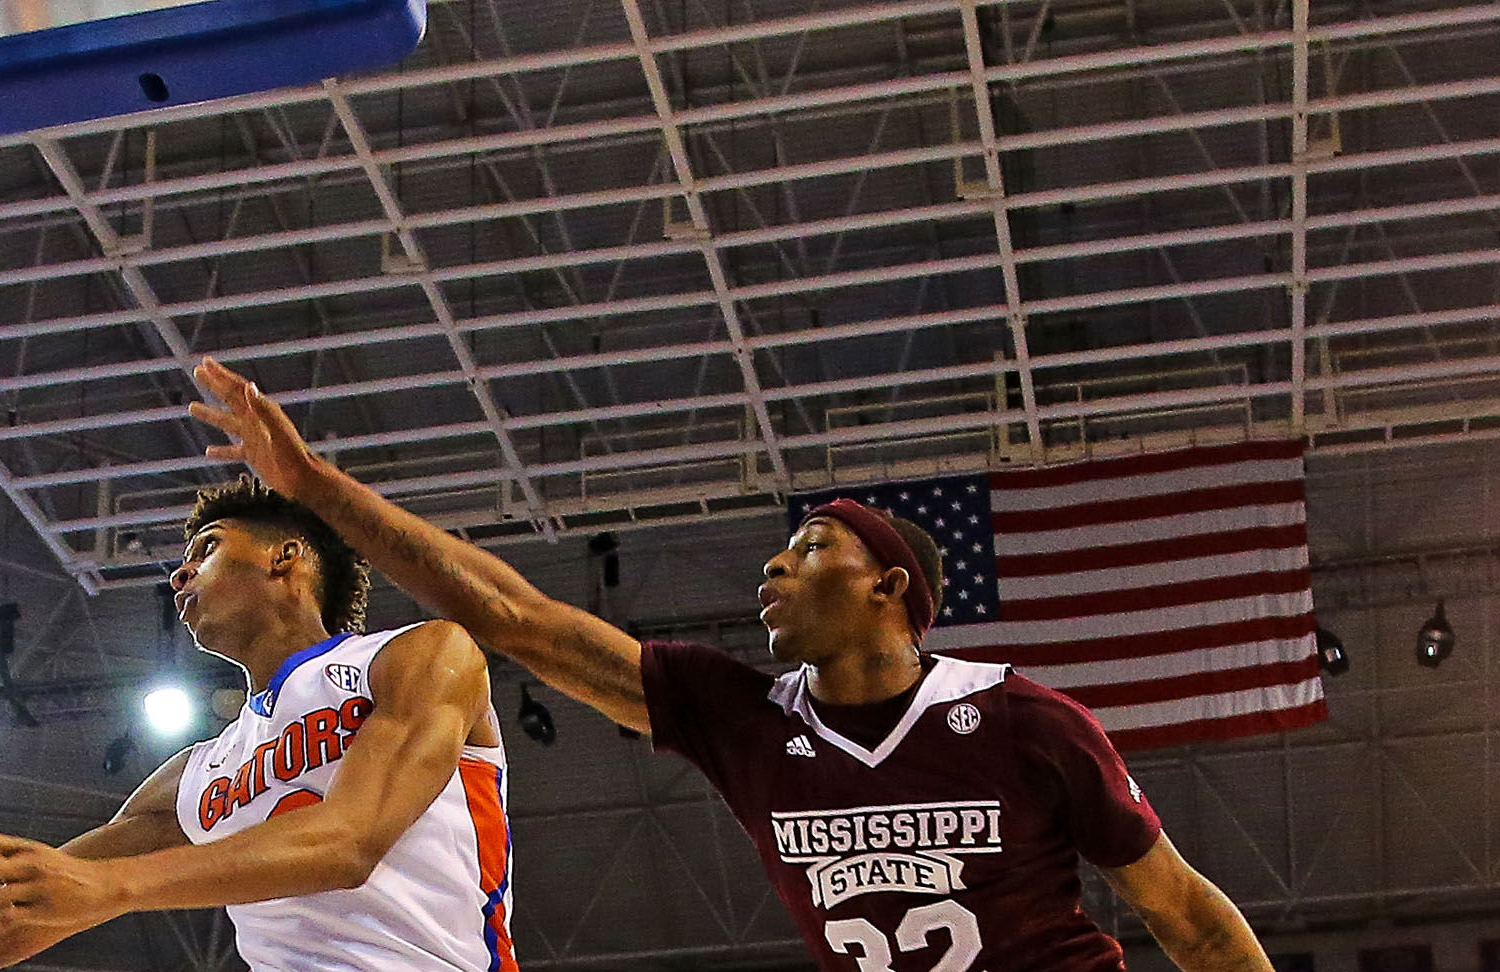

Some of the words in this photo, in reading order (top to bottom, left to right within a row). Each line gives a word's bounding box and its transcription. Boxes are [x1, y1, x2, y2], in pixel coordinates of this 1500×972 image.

[950, 705, 978, 731] SEC
[198, 696, 374, 832] GATORS
[772, 808, 1001, 855] MISSISSIPPI
[830, 859, 938, 897] STATE
